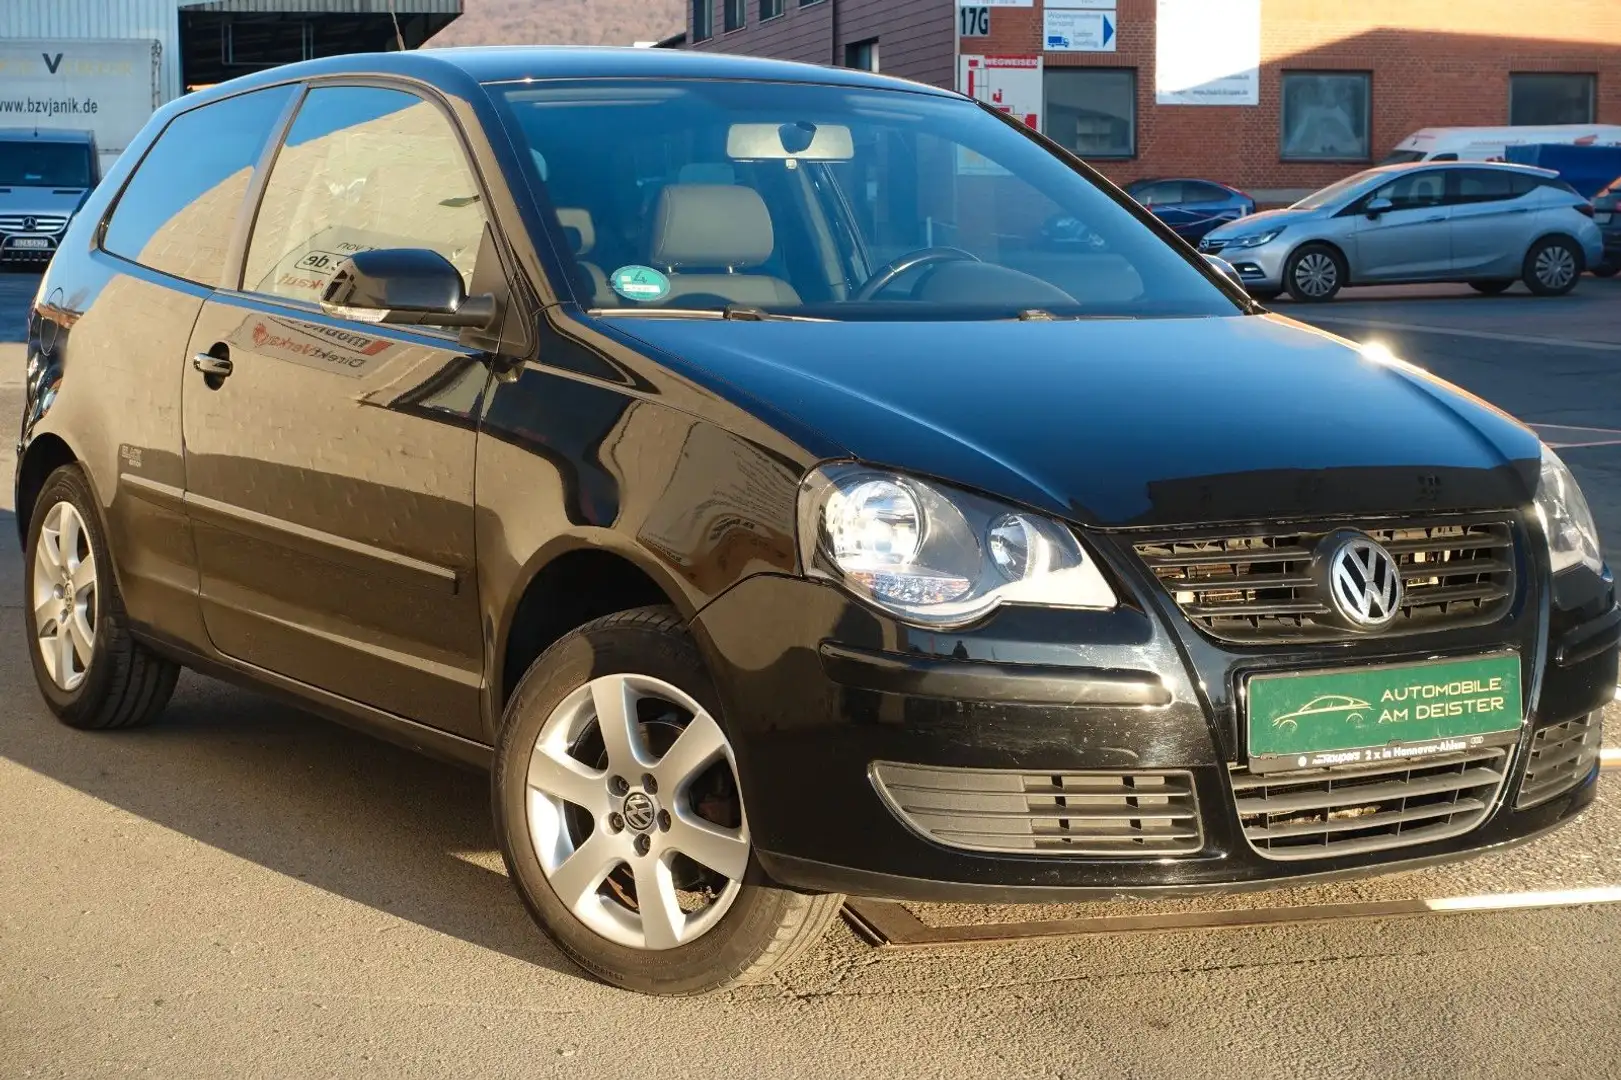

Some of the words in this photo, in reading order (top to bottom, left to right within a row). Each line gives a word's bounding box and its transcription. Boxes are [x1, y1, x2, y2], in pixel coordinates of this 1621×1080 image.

[960, 8, 988, 35] 17G
[984, 58, 1038, 66] WEGWEISER
[1380, 677, 1502, 703] AUTOMOBILE
[1378, 708, 1408, 724] AM
[1416, 696, 1505, 720] DEISTER
[1365, 749, 1372, 760] 2
[1374, 751, 1382, 760] x
[1382, 747, 1392, 758] in
